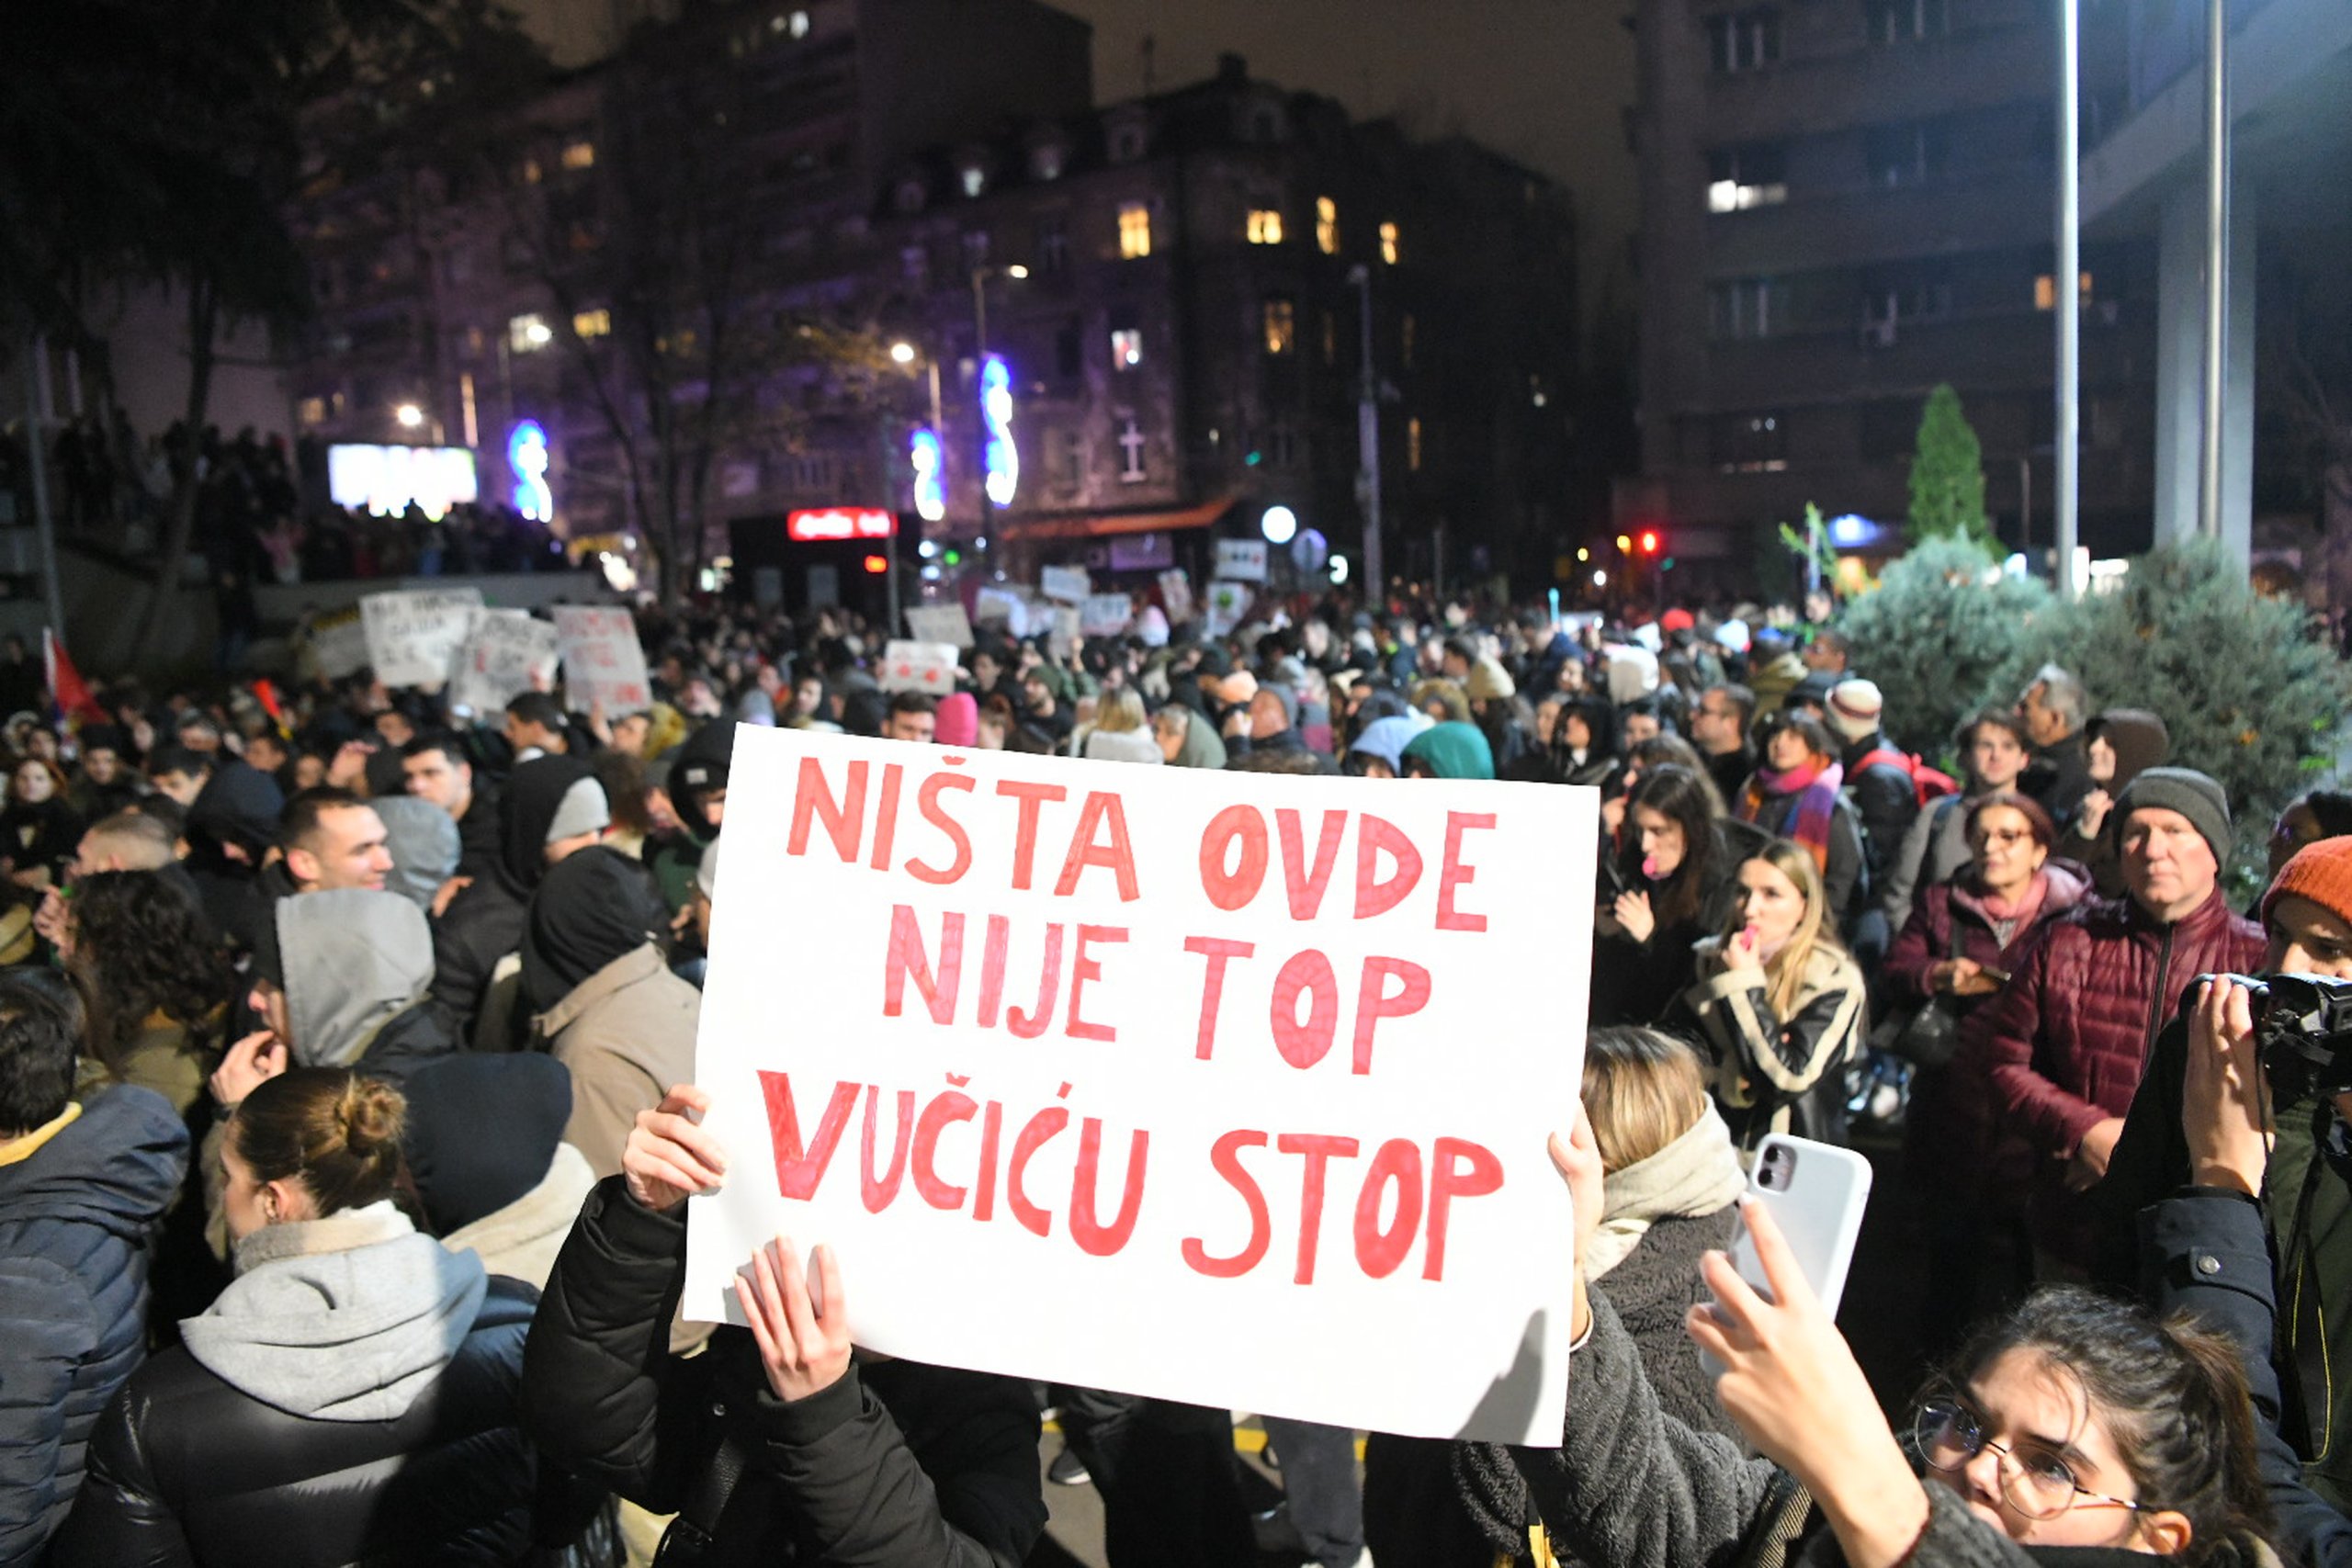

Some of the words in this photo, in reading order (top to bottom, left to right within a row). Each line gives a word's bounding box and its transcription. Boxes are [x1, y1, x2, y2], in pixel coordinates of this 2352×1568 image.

[787, 756, 1140, 902] NIŠTA
[1199, 805, 1498, 932] OVDE
[883, 905, 1130, 1042] NIJE
[1184, 936, 1431, 1076] TOP
[757, 1070, 1149, 1257] VUČIĆU
[1182, 1129, 1505, 1284] STOP
